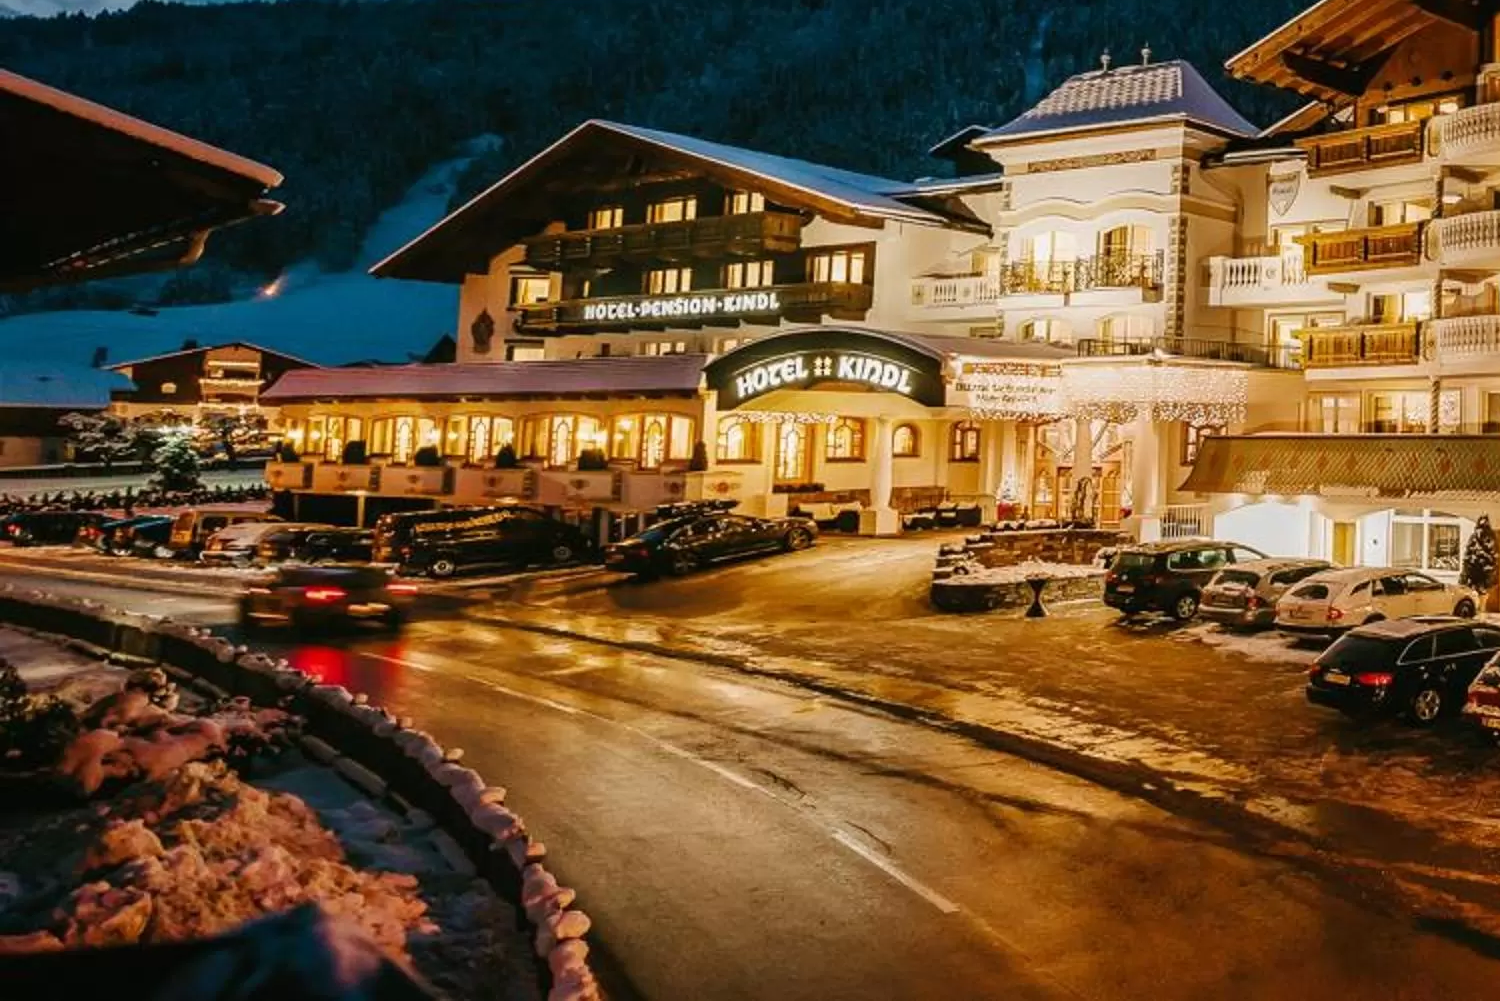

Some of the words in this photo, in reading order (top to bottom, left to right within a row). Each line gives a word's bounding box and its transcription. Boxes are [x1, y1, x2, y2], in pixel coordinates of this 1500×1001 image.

[723, 293, 780, 312] KINDL
[735, 357, 809, 398] HOTEL
[837, 356, 912, 394] KINDL
